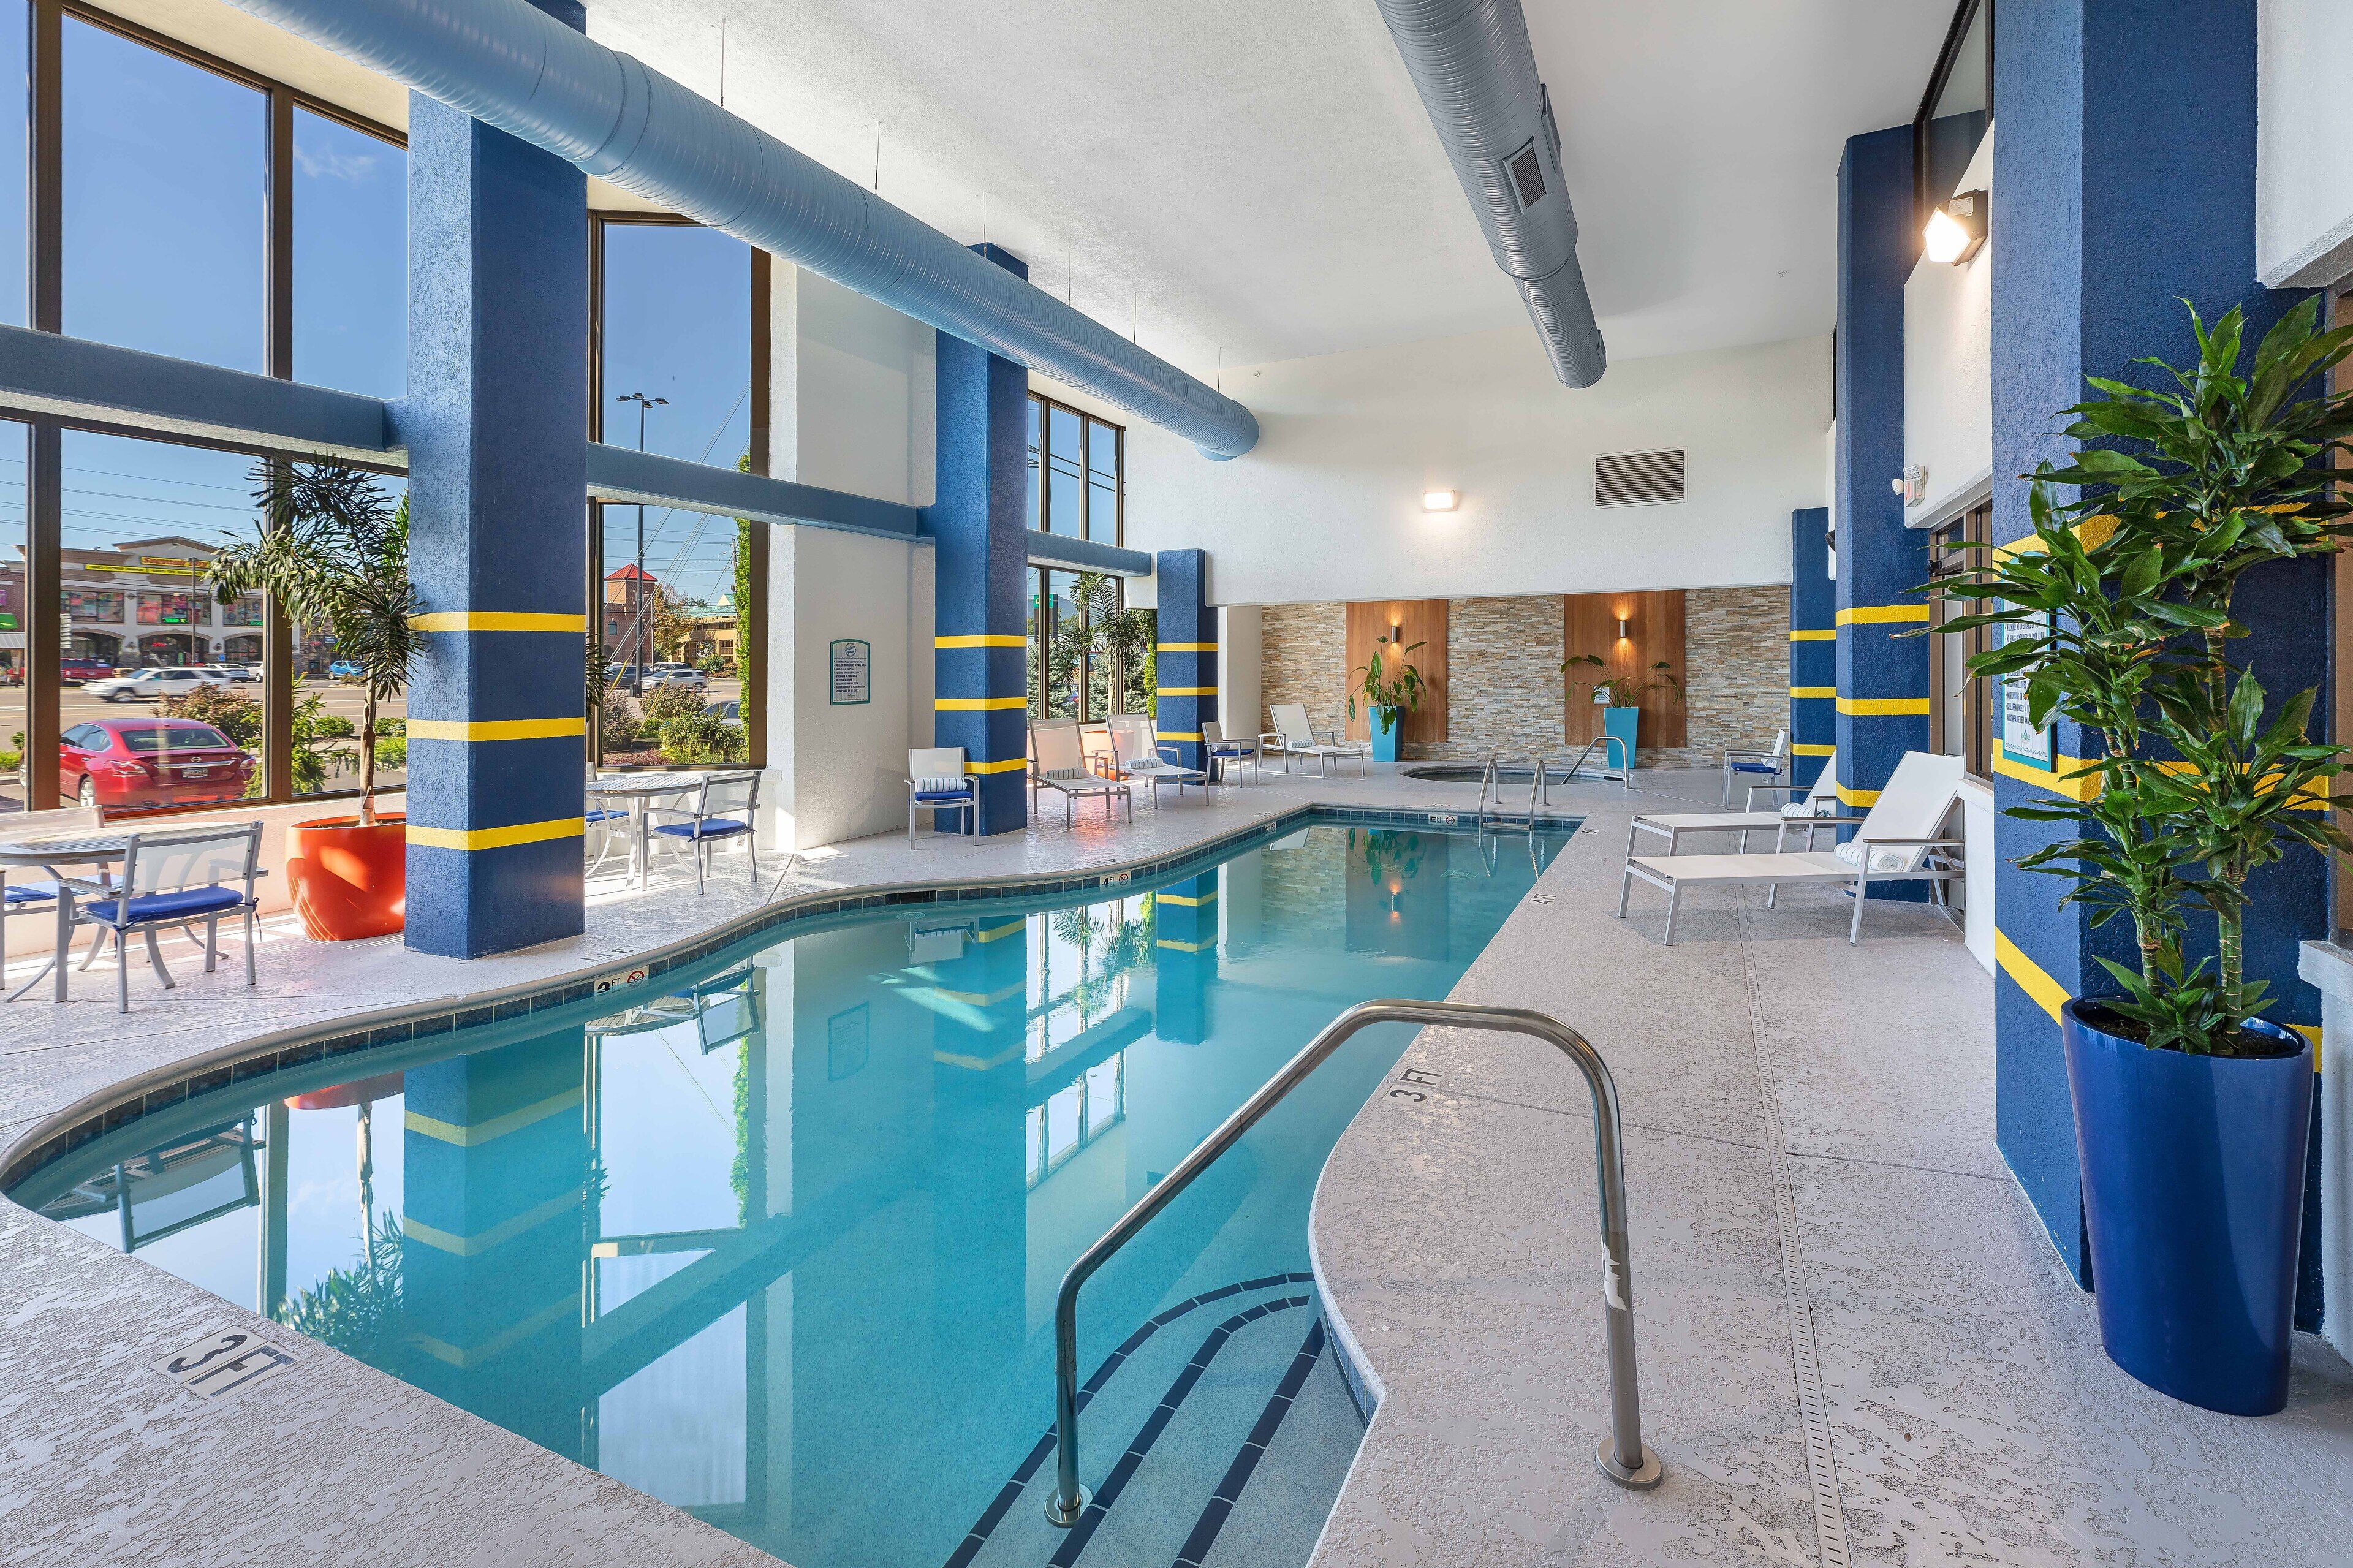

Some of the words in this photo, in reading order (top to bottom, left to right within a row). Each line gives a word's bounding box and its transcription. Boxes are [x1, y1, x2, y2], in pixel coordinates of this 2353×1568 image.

[2007, 714, 2021, 723] ACCOMPANIED
[1102, 877, 1108, 886] 4
[597, 982, 610, 994] 3
[612, 977, 621, 987] FT
[1400, 1068, 1442, 1086] FT
[1390, 1089, 1427, 1102] 3
[167, 1334, 248, 1373] 3
[189, 1345, 297, 1398] FT
